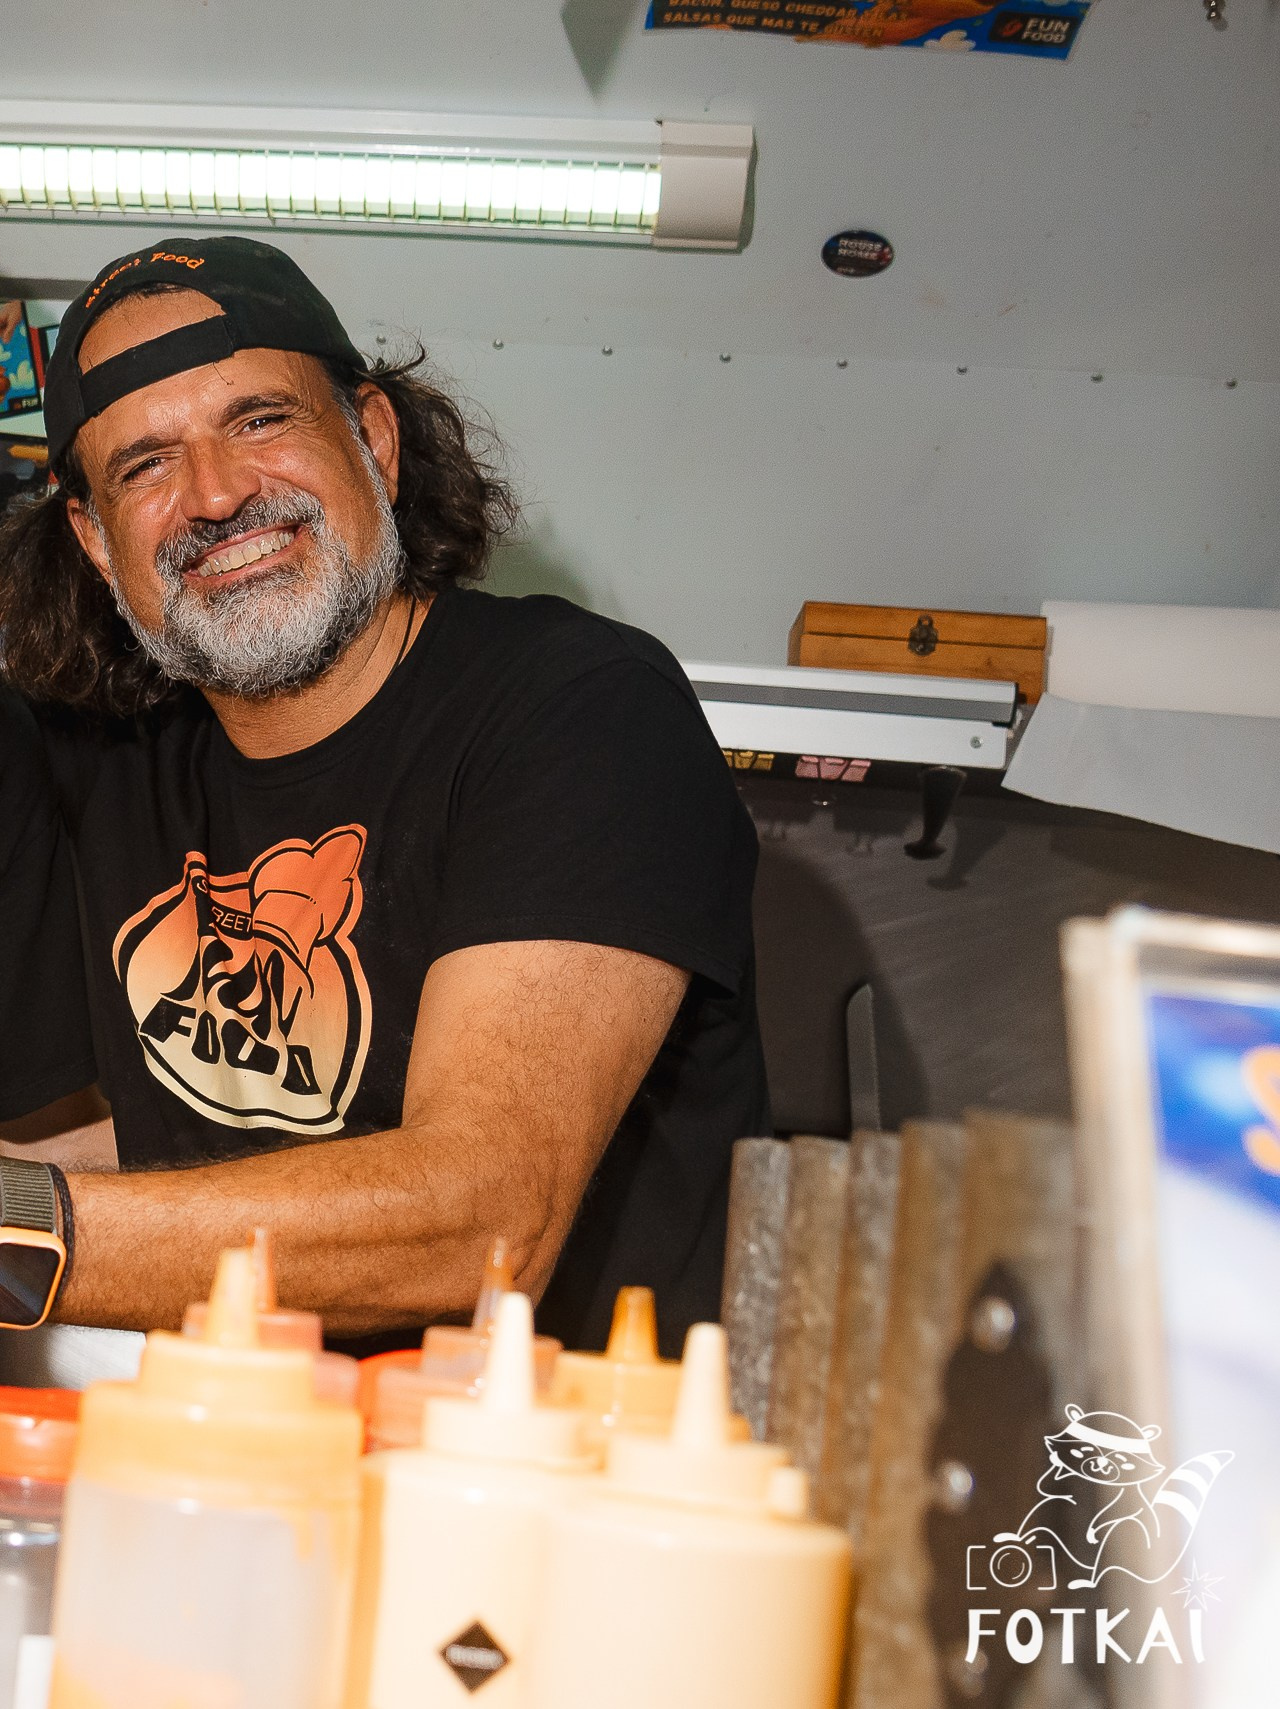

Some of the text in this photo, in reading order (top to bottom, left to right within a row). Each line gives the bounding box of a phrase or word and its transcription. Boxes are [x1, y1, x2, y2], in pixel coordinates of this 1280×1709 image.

[663, 11, 721, 23] SALSAS
[726, 14, 756, 25] QUE
[1026, 17, 1070, 32] FUN
[1022, 31, 1066, 43] FOOD
[150, 251, 205, 270] Food
[196, 879, 252, 933] SREET
[138, 997, 324, 1096] FOOD
